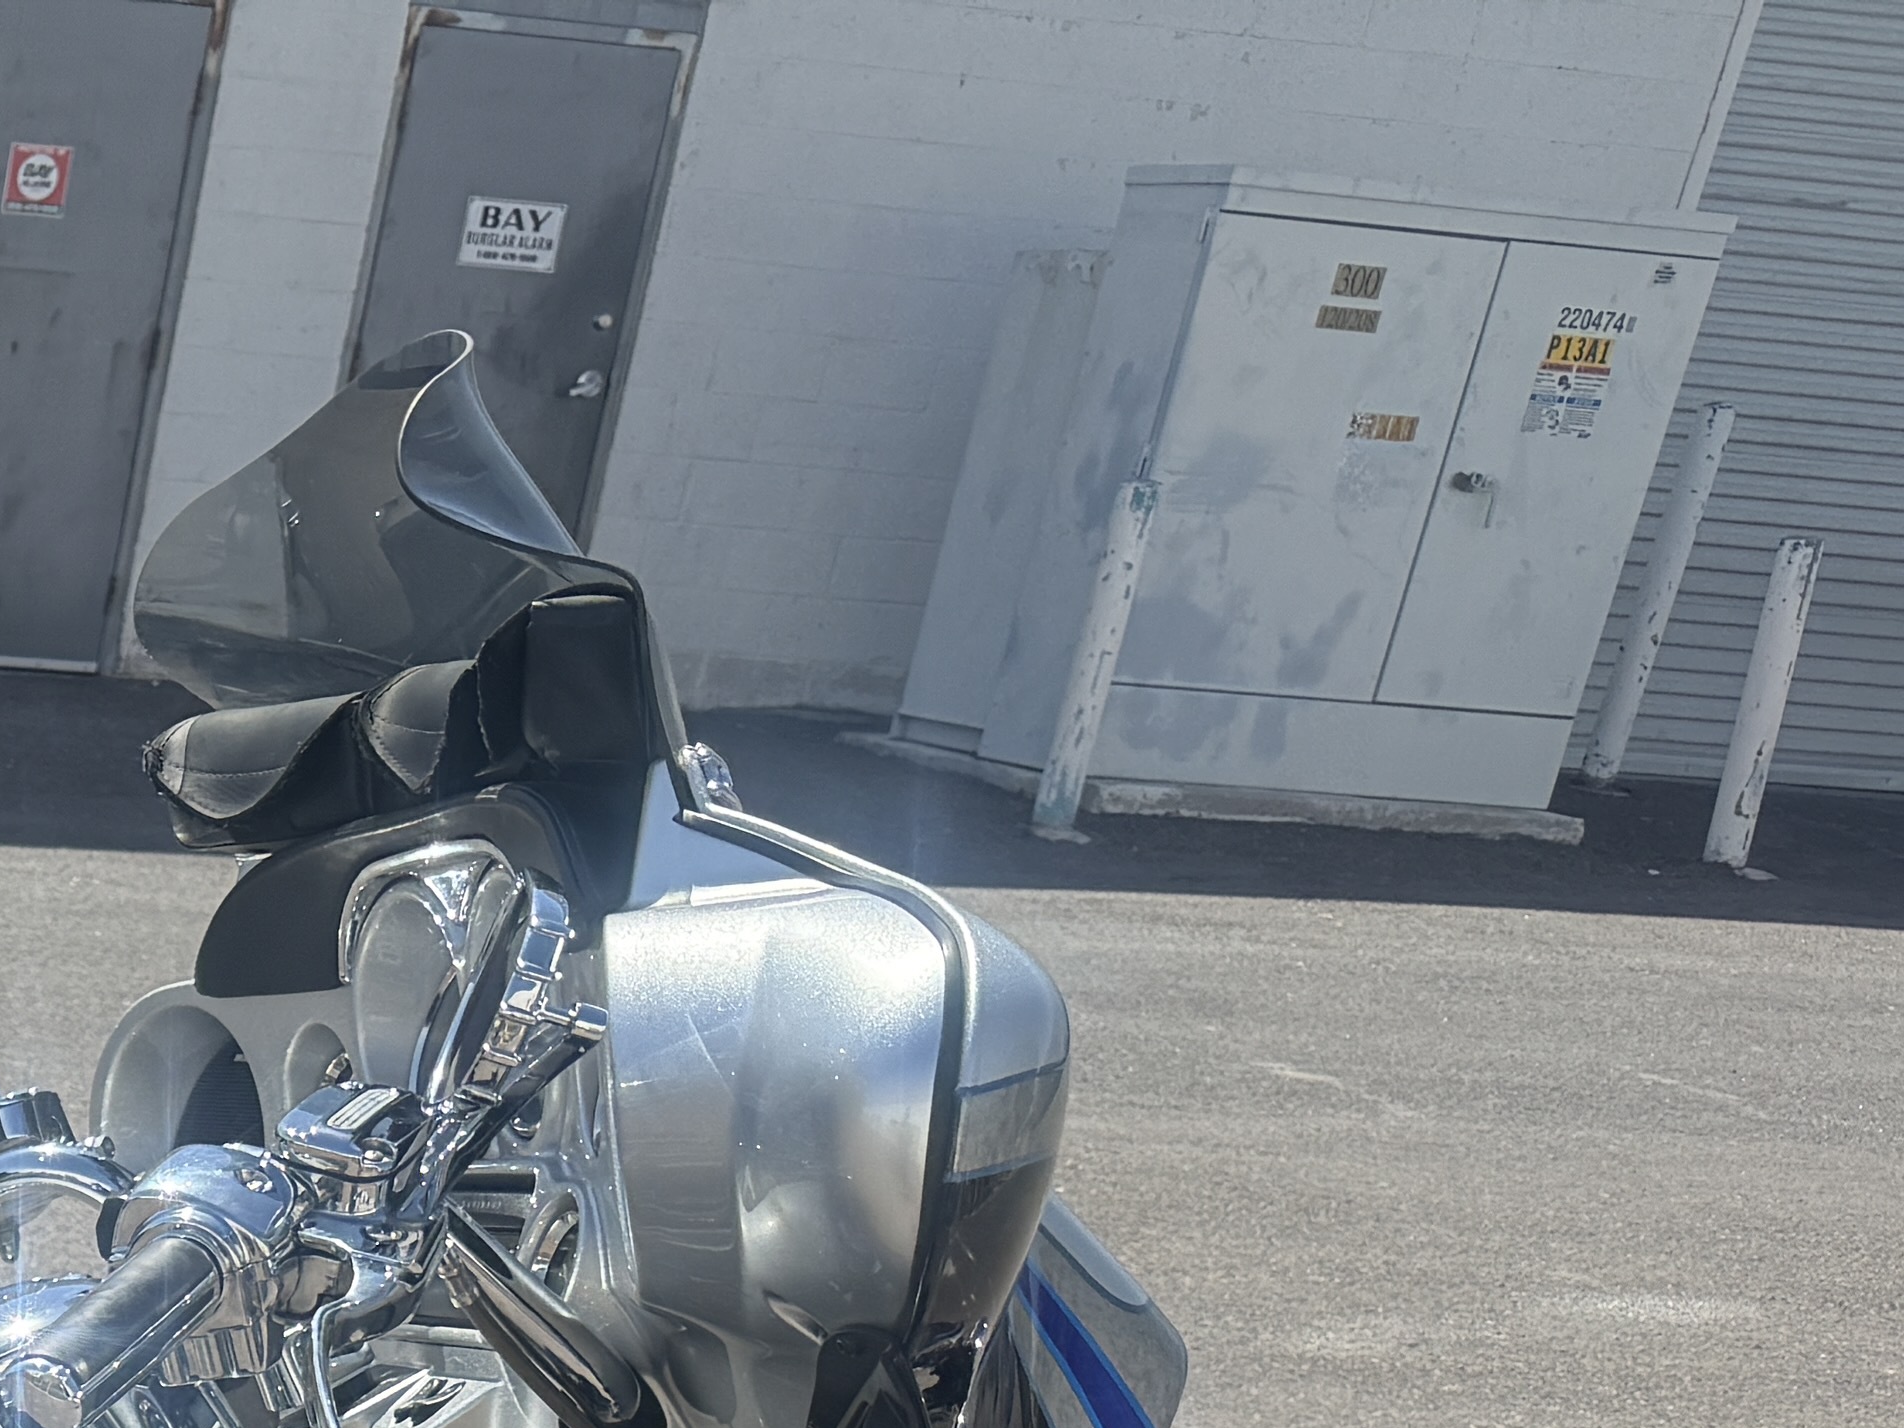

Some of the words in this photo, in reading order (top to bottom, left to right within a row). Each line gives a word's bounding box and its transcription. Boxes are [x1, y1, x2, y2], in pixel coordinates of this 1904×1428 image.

[480, 205, 553, 232] BAY
[1334, 264, 1381, 298] 300
[1558, 307, 1627, 333] 220474
[1547, 335, 1612, 364] P13A1
